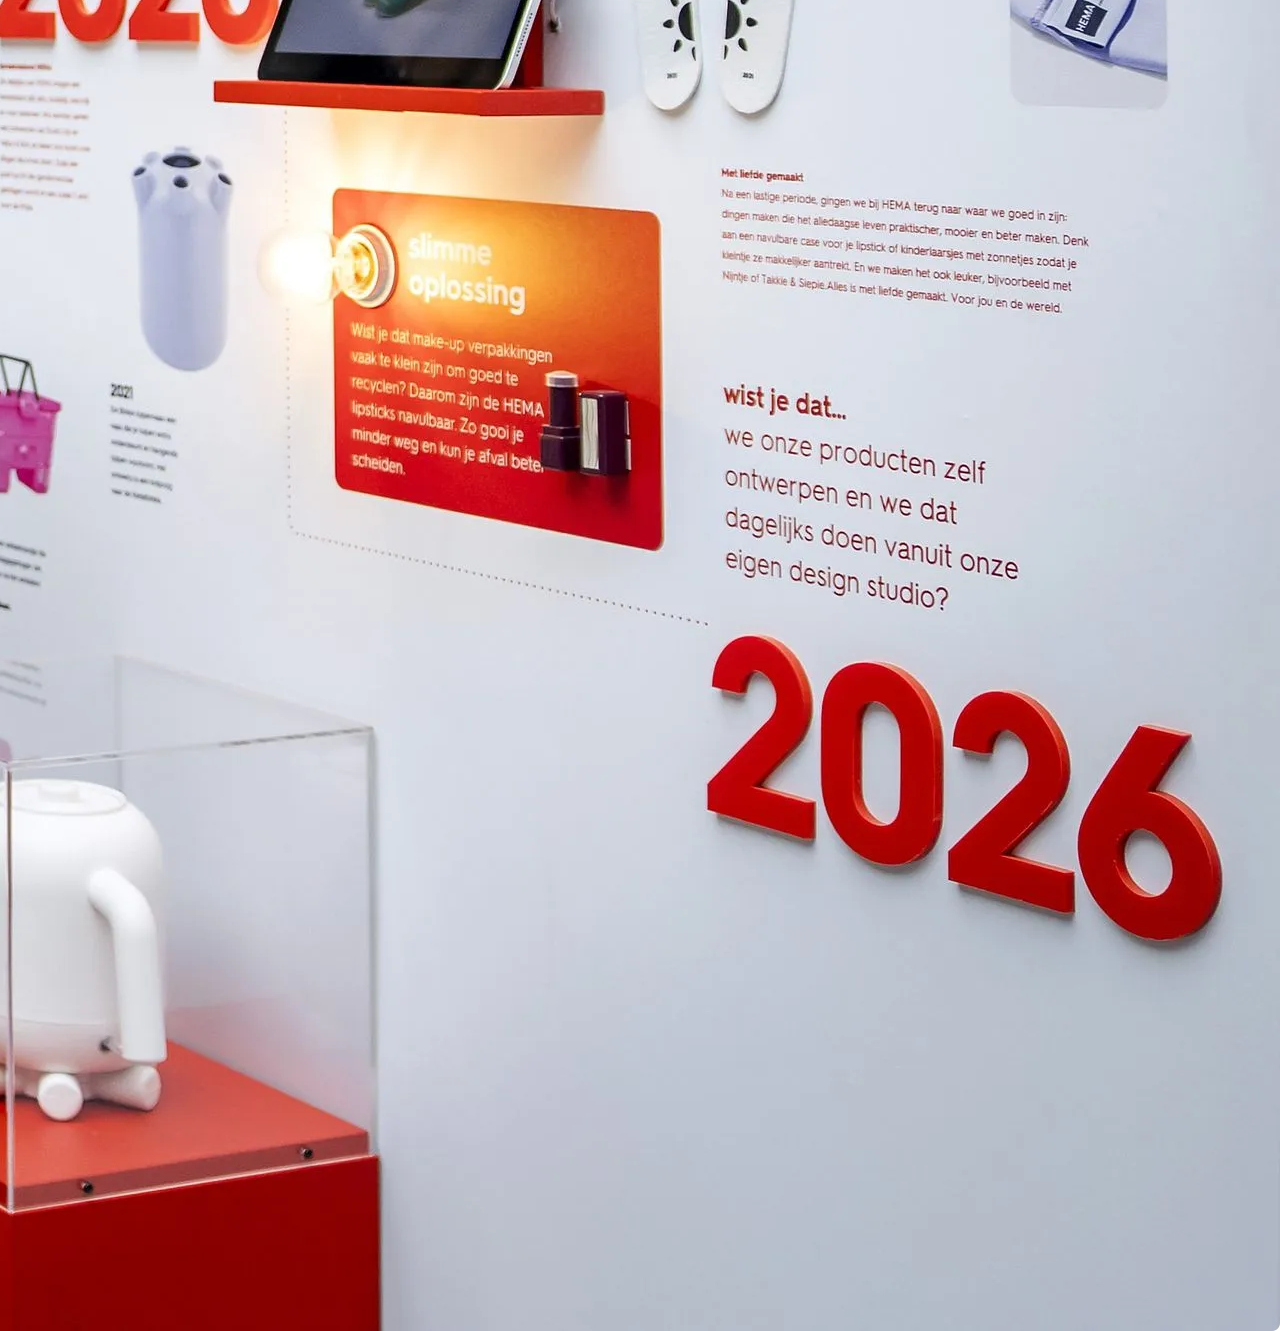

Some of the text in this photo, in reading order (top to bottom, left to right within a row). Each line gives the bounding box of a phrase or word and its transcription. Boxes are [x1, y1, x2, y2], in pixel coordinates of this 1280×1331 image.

[1075, 4, 1096, 32] HEMA
[408, 232, 492, 266] slimme
[409, 274, 525, 315] oplossing
[350, 321, 552, 366] Wist je dat make-up verpakkingen
[350, 350, 518, 387] vaak te klein zijn om goed te
[351, 376, 544, 418] recyclen? Daarom zijn de HEMA
[723, 383, 846, 420] wist je dat...
[351, 399, 524, 445] lipsticks navulbaar. Zo gooi je
[351, 427, 391, 446] minder
[393, 436, 419, 455] weg
[420, 440, 437, 454] en
[438, 440, 461, 458] kun
[463, 445, 476, 464] je
[477, 448, 508, 467] afval
[351, 453, 405, 475] scheiden.
[724, 428, 986, 484] we onze producten zelf
[725, 468, 957, 525] ontwerpen en we dat
[725, 507, 1018, 580] dagelijks doen vanuit onze
[725, 549, 948, 611] eigen design studio?
[707, 635, 1223, 941] 2026
